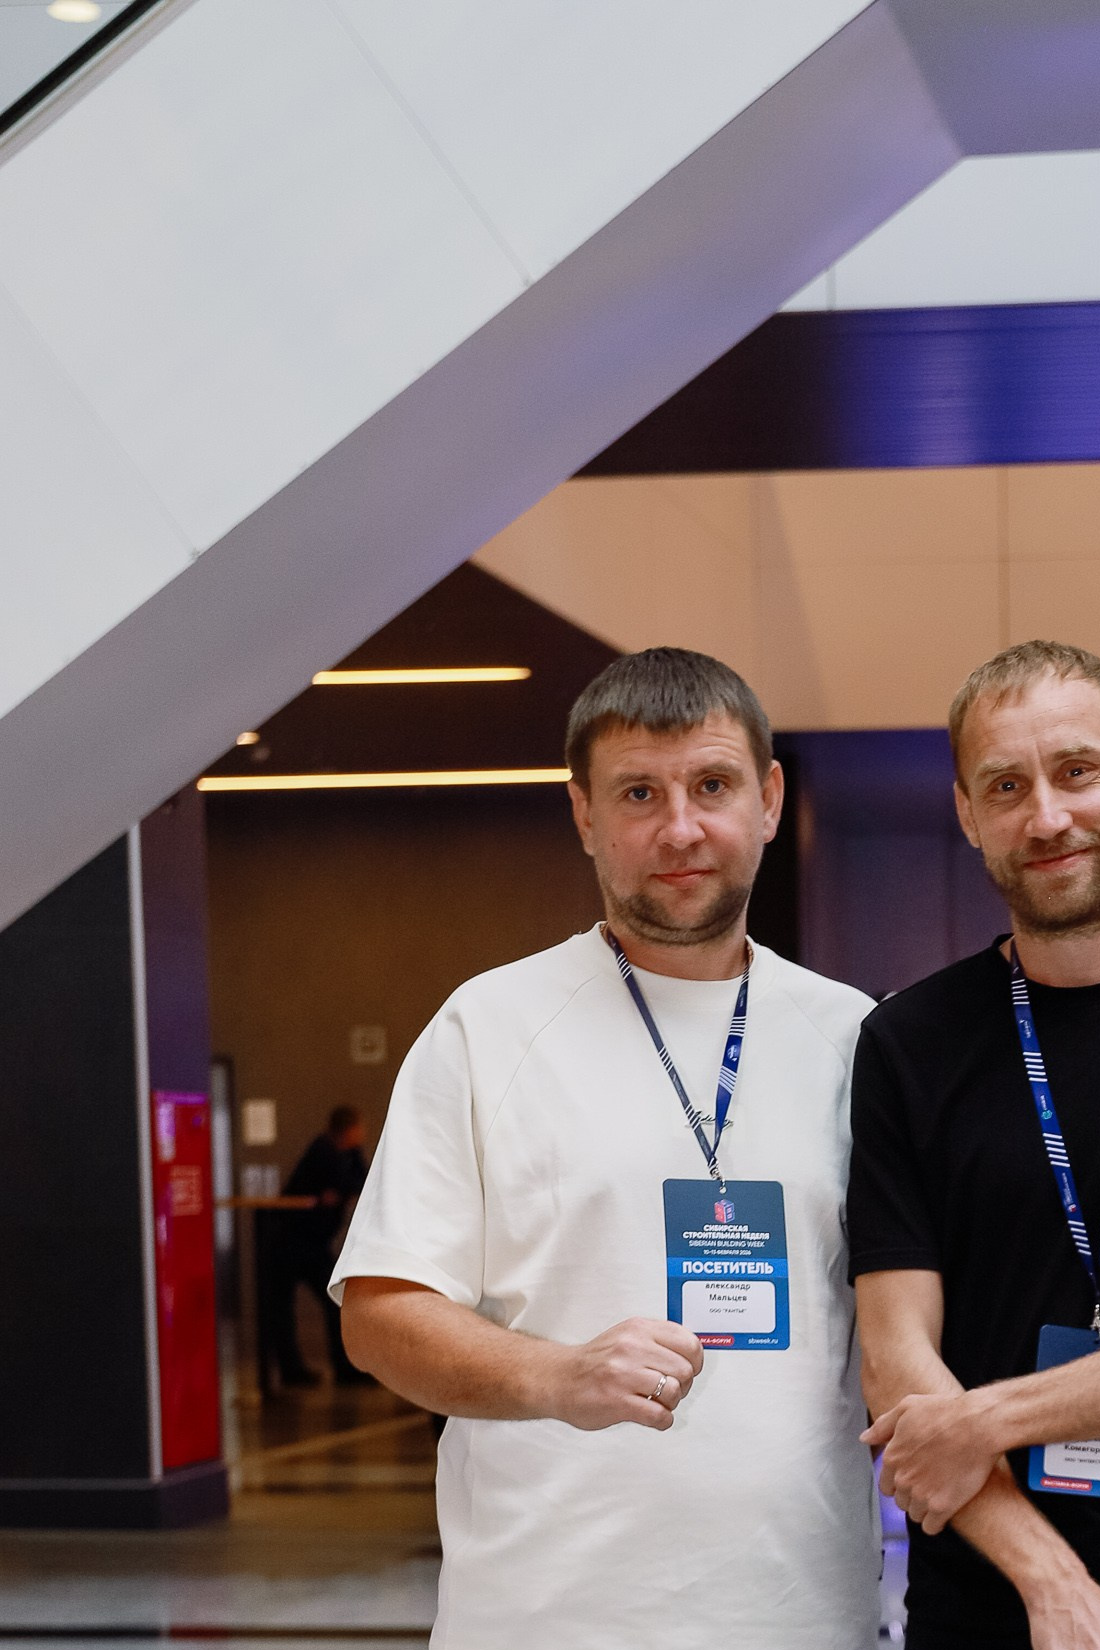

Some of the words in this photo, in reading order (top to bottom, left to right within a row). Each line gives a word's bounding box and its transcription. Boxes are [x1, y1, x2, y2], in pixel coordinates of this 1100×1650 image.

[703, 1224, 749, 1232] СИБИРСКАЯ
[682, 1231, 740, 1240] СТРОИТЕЛЬНАЯ
[740, 1232, 770, 1240] НЕДЕЛЯ
[682, 1261, 774, 1275] ПОСЕТИТЕЛЬ
[709, 1294, 748, 1302] Мальцев
